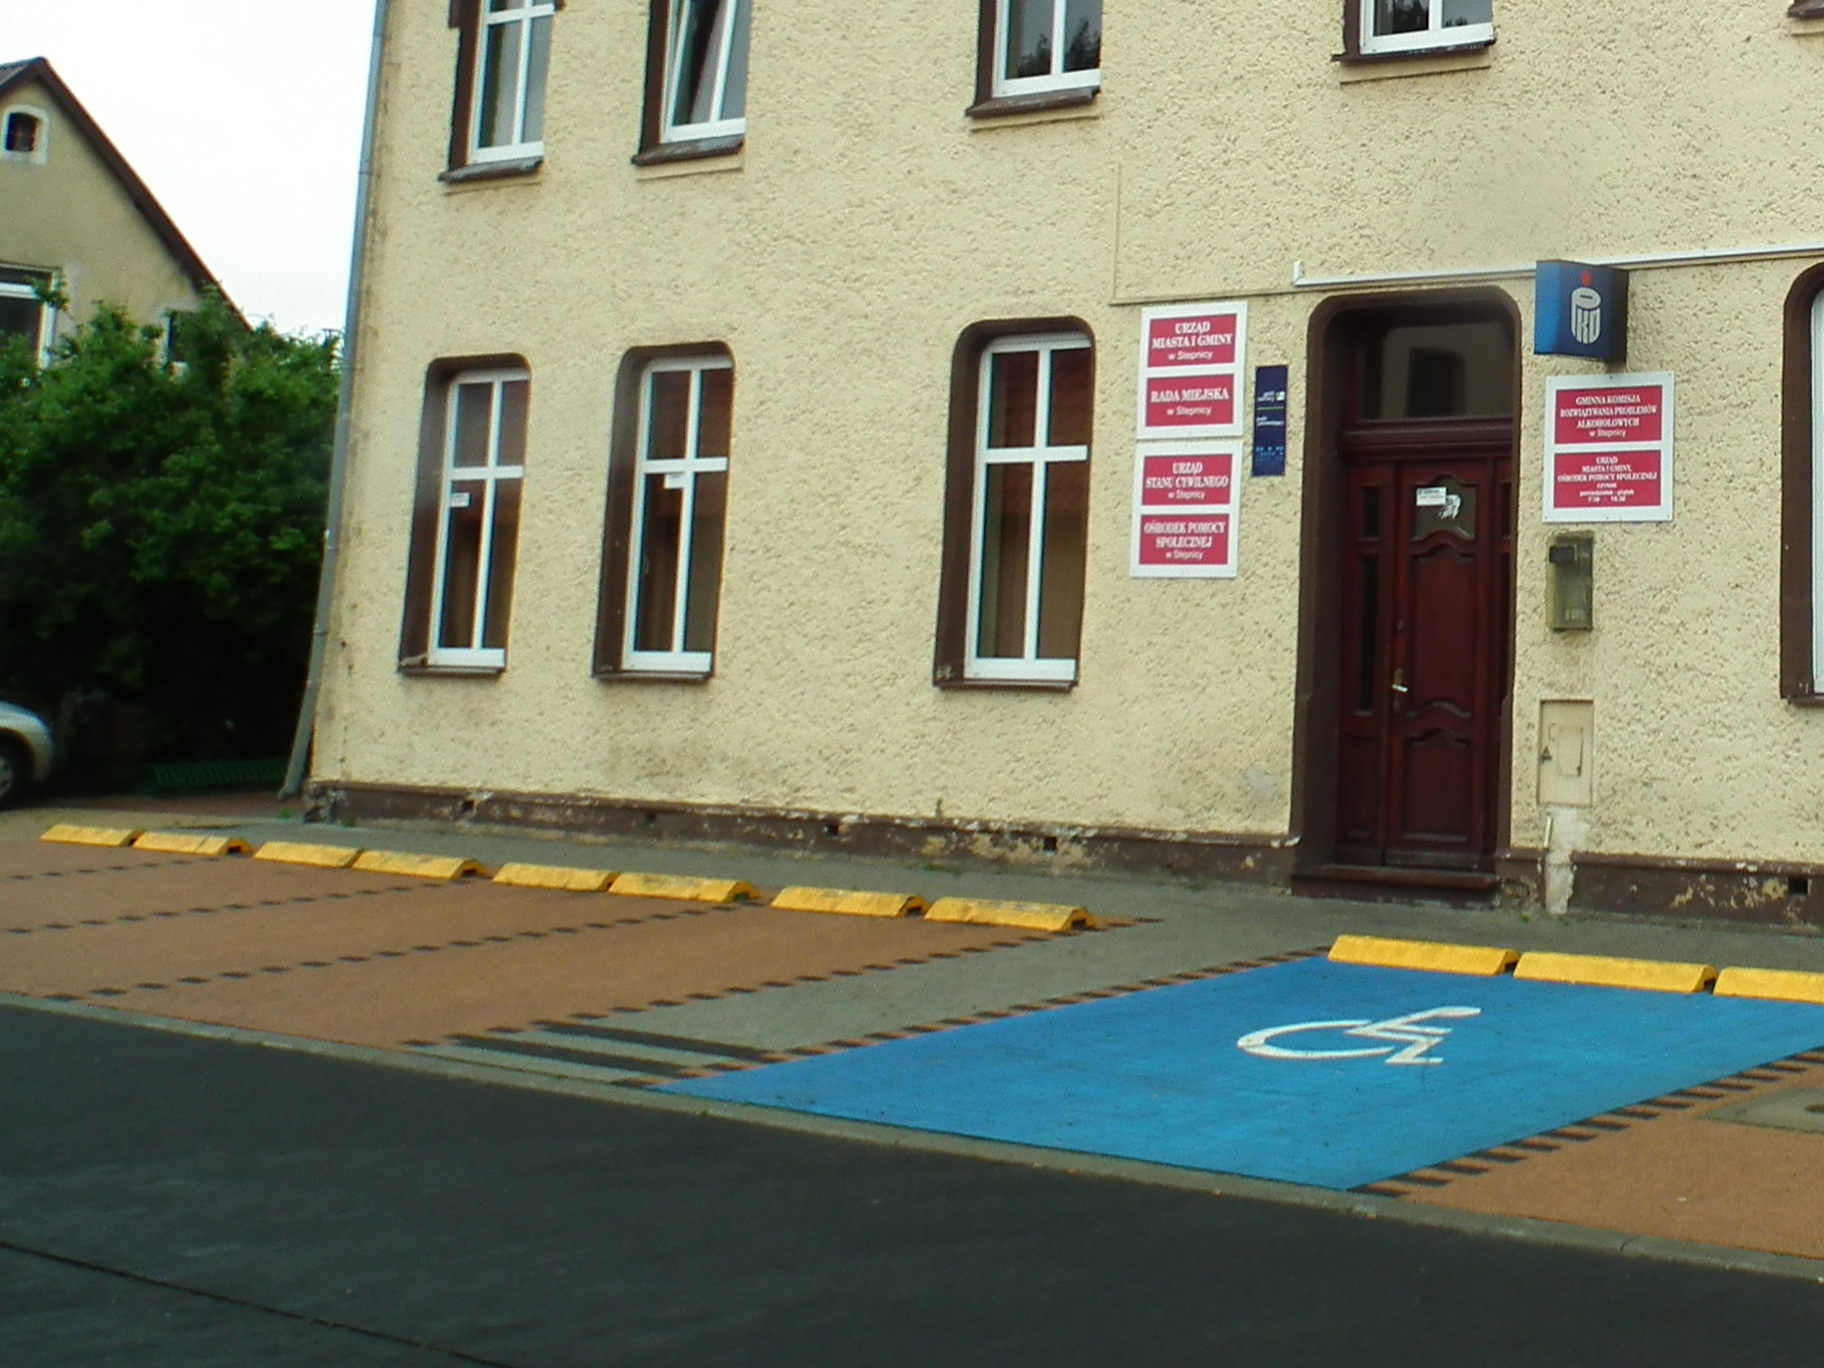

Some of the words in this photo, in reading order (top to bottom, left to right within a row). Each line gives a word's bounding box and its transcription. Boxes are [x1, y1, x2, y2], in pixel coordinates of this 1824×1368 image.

[1175, 321, 1211, 334] URZĄD
[1151, 336, 1189, 349] MIASTA
[1190, 335, 1196, 346] I
[1197, 333, 1233, 347] GMINY
[1168, 352, 1176, 360] w
[1177, 350, 1213, 361] Stepnicy
[1151, 390, 1180, 403] RADA
[1181, 388, 1229, 402] MIEJSKA
[1575, 395, 1606, 406] GMINNA
[1607, 395, 1640, 404] KOMISJA
[1166, 408, 1174, 416] w
[1176, 405, 1212, 416] Stepnicy
[1560, 407, 1613, 418] ROZWIĄZYWANIA
[1614, 405, 1657, 415] PROBLEMÓW
[1577, 418, 1640, 429] ALKOHOLOWYCH
[1596, 428, 1627, 438] Stepnicy
[1172, 462, 1203, 475] URZĄD
[1582, 465, 1605, 473] MIASTA
[1145, 476, 1174, 489] STANU
[1175, 475, 1229, 488] CYWILNEGO
[1167, 491, 1175, 499] w
[1176, 489, 1205, 500] Stepnicy
[1143, 520, 1187, 534] OŚRODEK
[1187, 521, 1227, 534] POMOCY
[1165, 551, 1173, 559] w
[1173, 549, 1204, 560] Stepnicy
